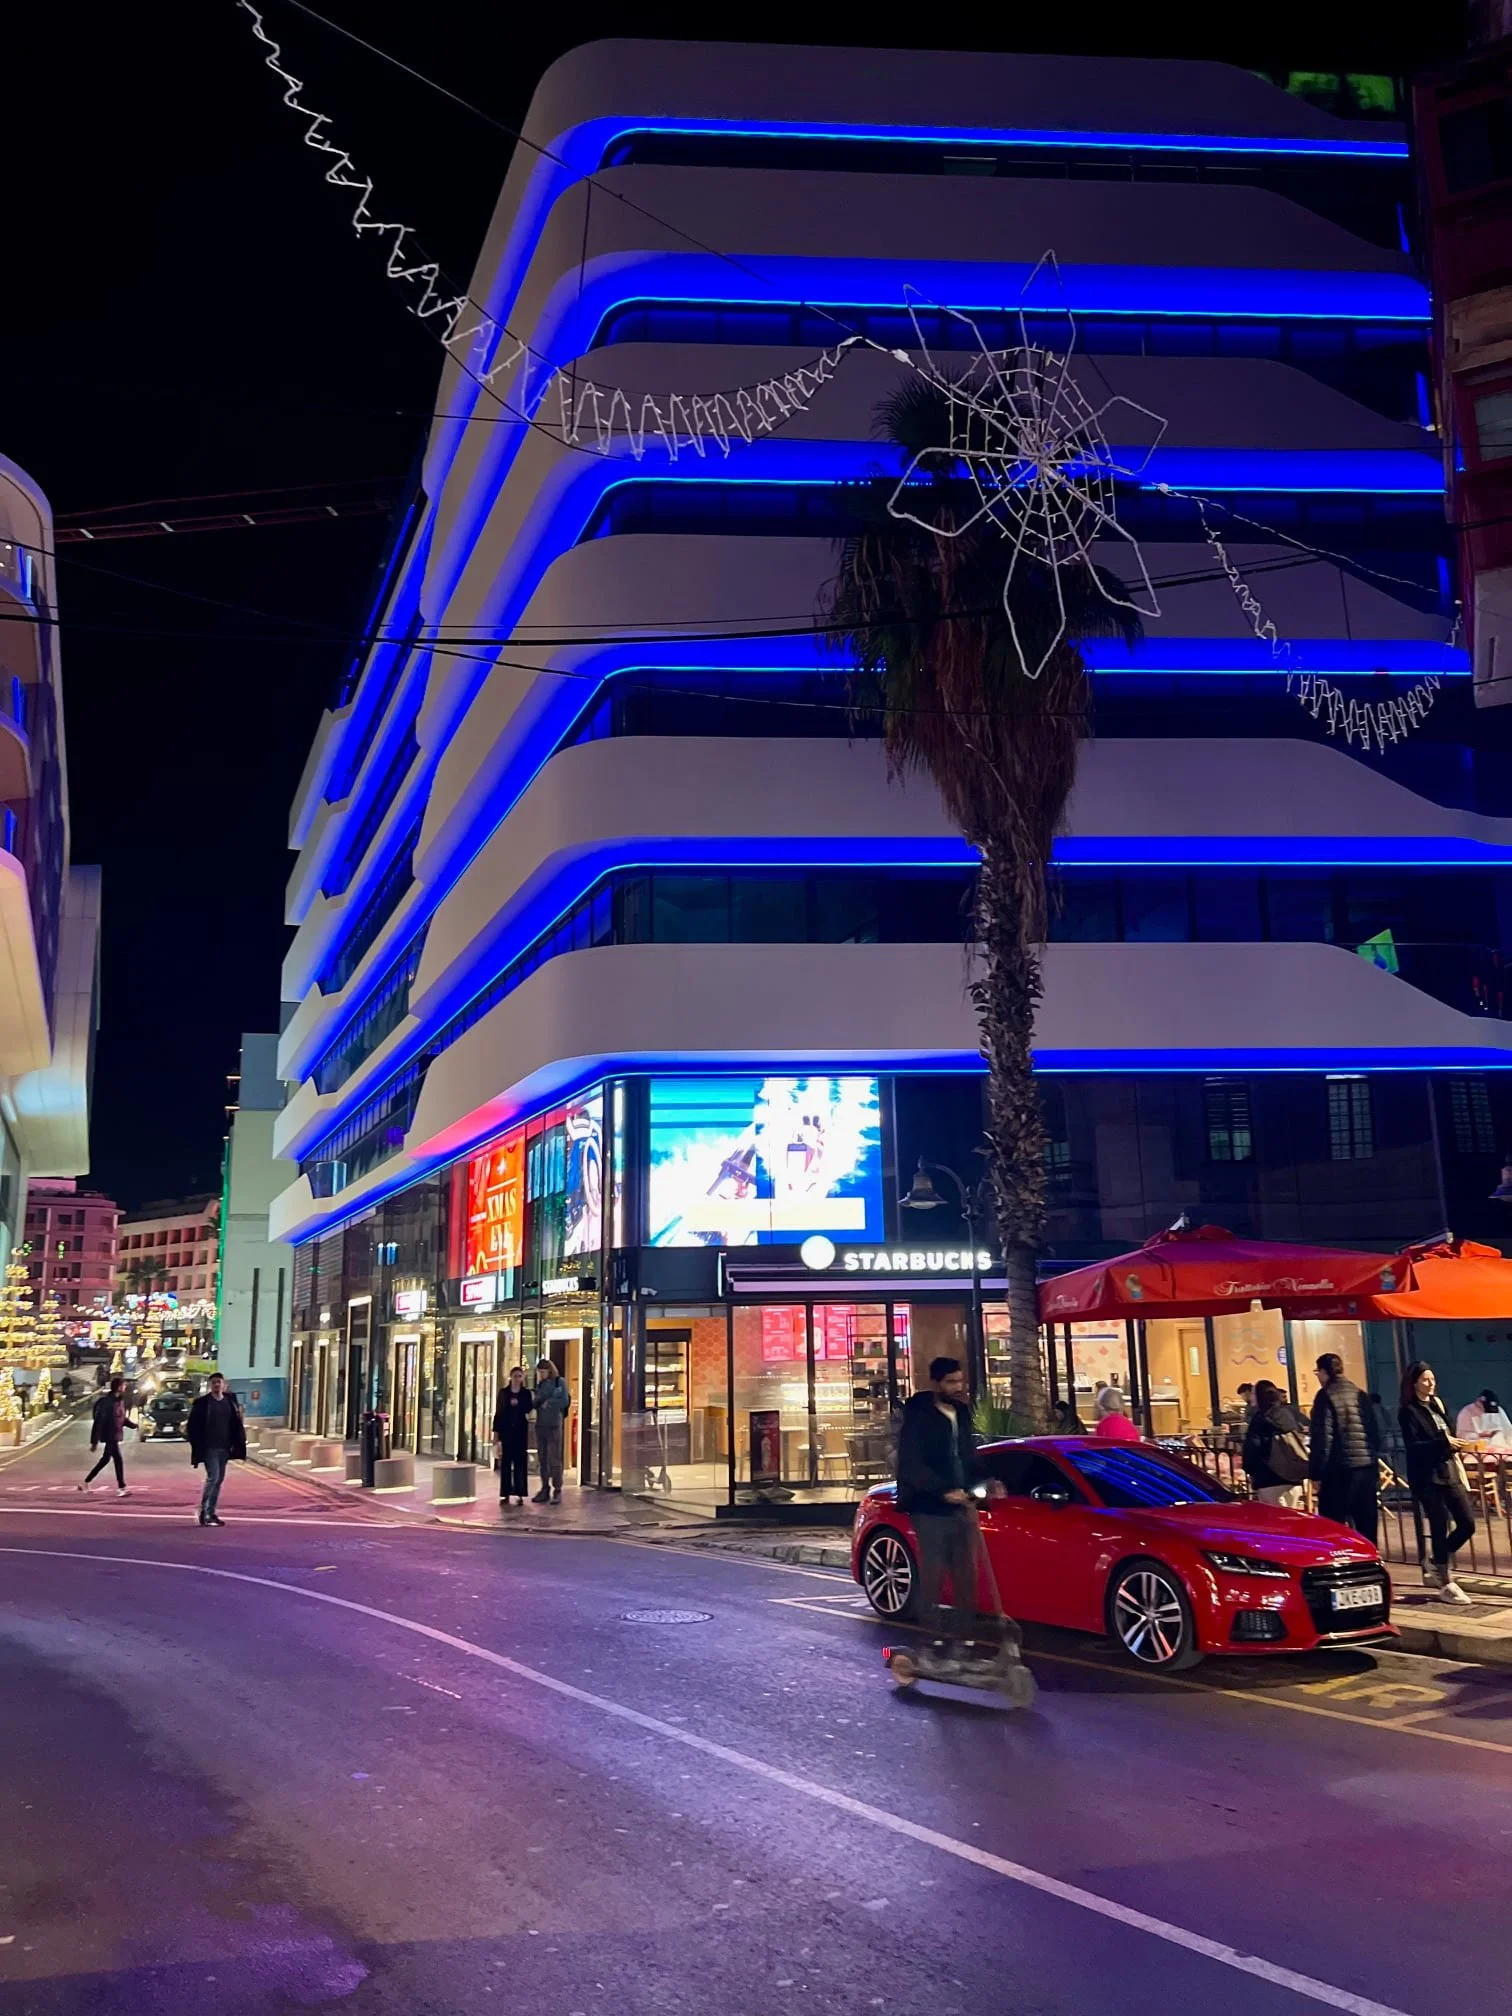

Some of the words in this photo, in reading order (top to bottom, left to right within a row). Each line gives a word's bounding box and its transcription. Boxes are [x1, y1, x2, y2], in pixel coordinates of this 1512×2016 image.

[487, 1189, 517, 1222] XMAS
[490, 1220, 514, 1252] EVE
[844, 1251, 992, 1271] STARBUCKS
